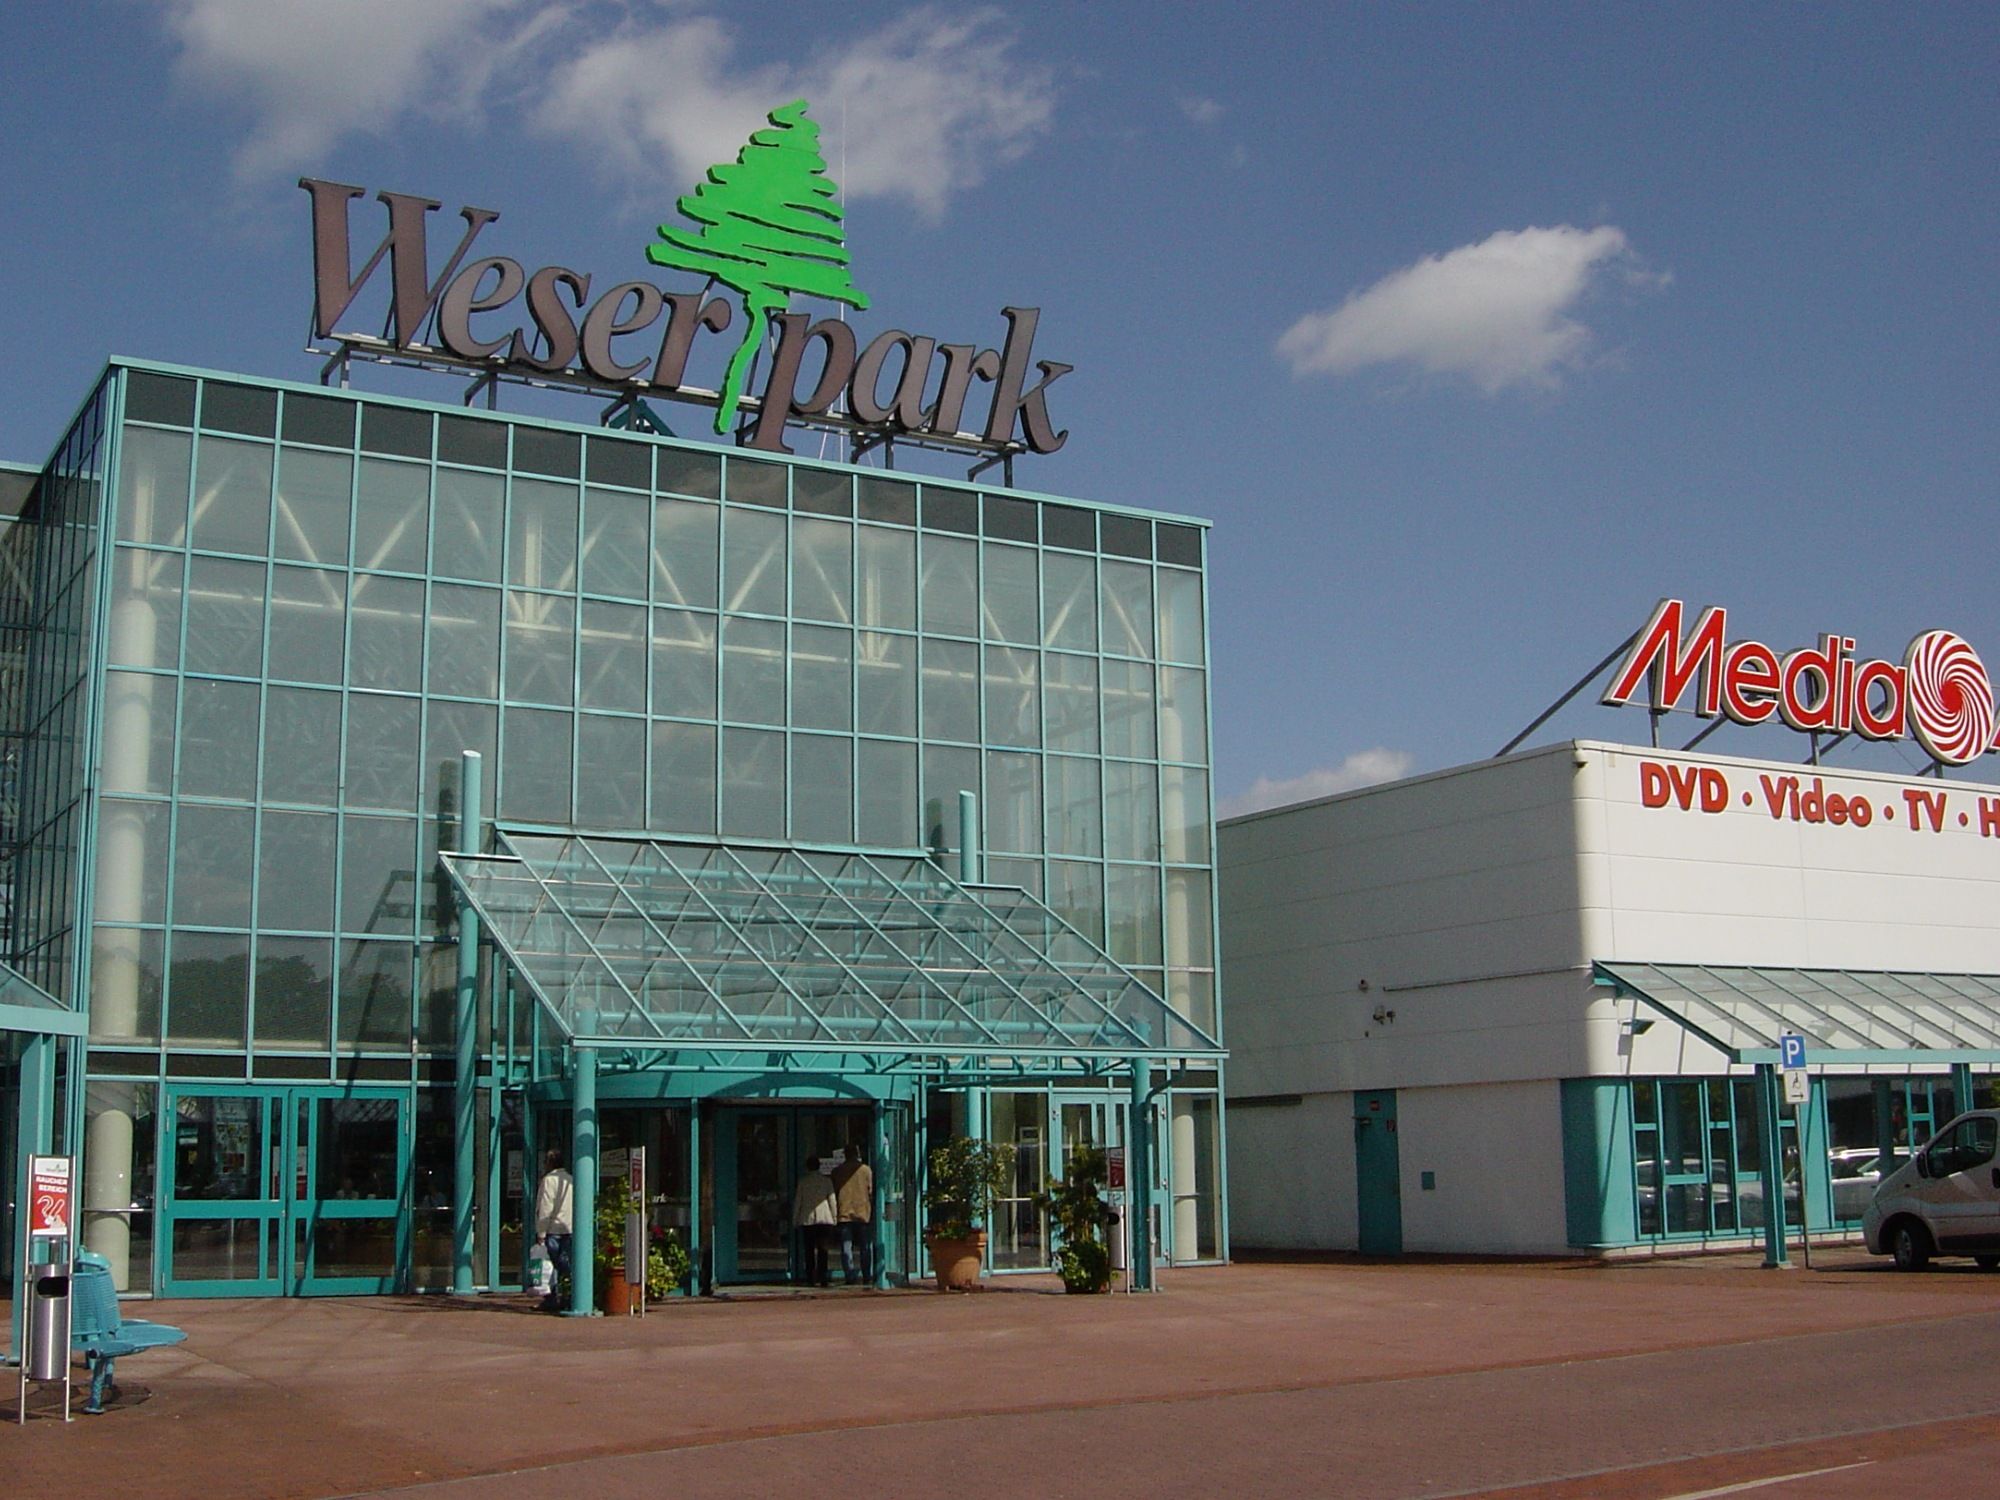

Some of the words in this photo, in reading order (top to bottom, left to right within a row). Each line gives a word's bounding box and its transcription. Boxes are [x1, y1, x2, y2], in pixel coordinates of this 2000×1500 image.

[1602, 598, 1908, 740] Media
[1640, 762, 1729, 813] DVD
[1760, 774, 1872, 828] Video
[1903, 788, 1947, 833] TV
[1786, 1039, 1800, 1065] P
